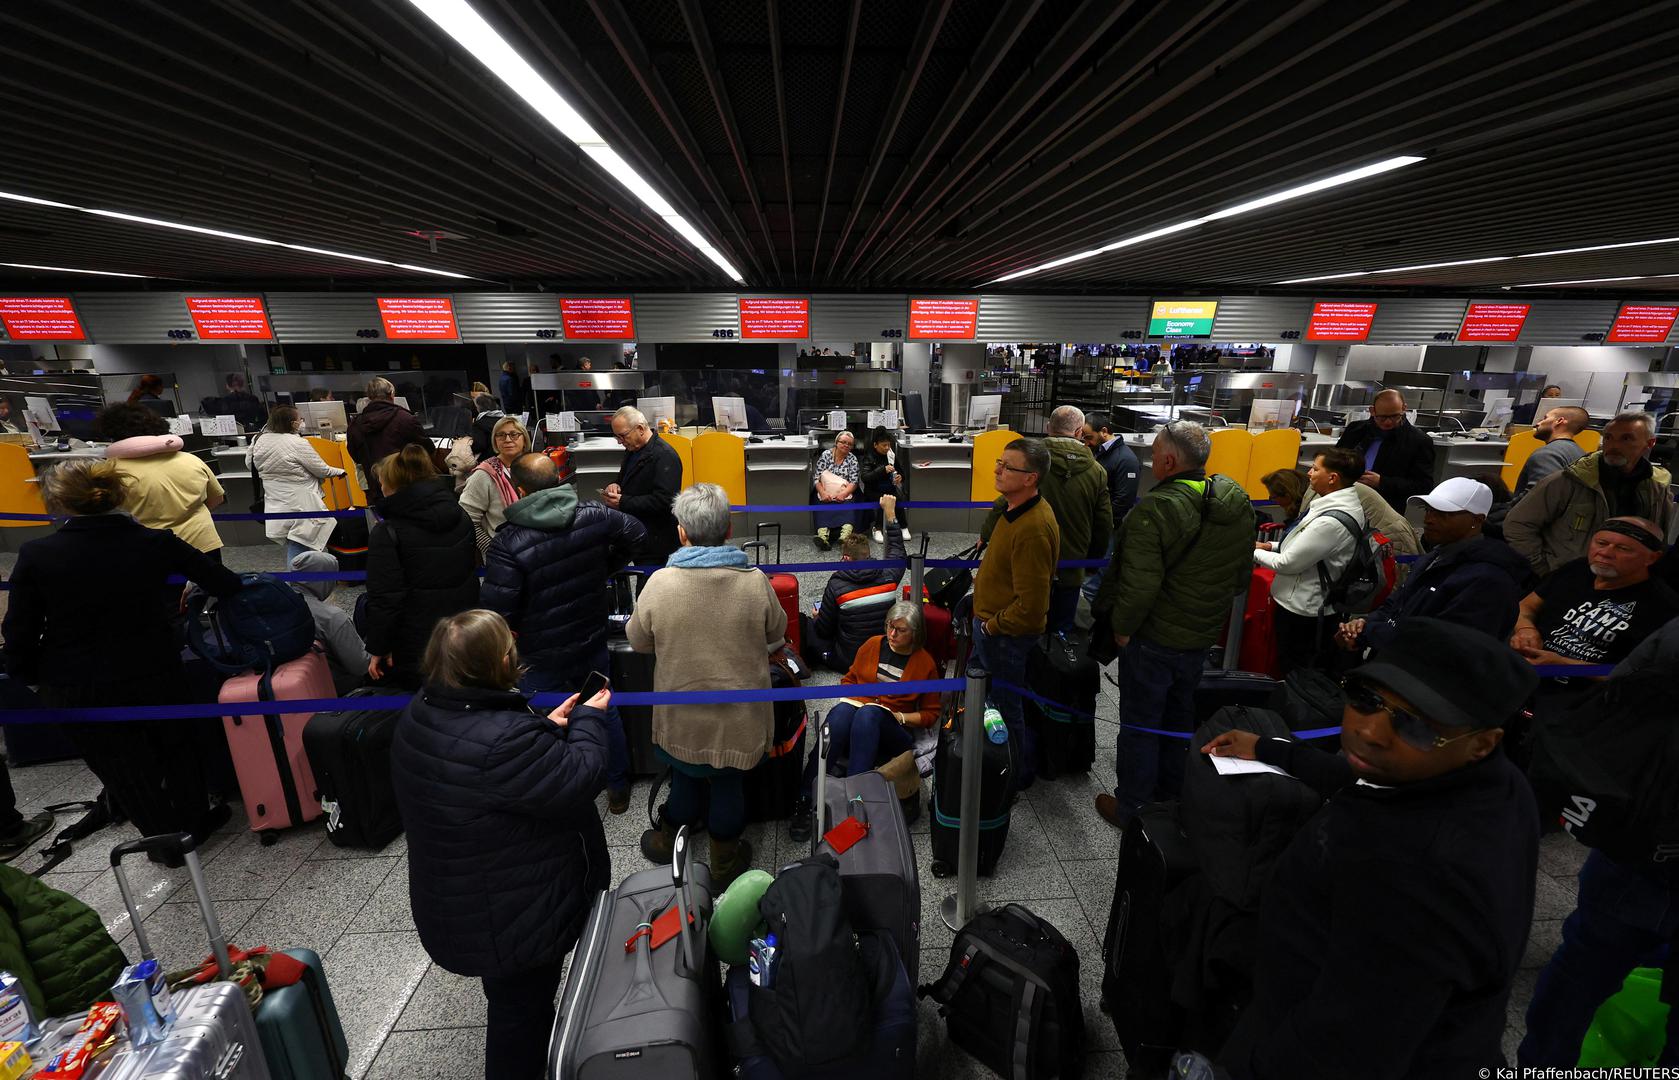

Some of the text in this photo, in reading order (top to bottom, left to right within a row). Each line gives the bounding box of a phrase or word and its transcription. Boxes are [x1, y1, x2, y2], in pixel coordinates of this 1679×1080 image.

[1166, 320, 1195, 328] Economy
[536, 329, 557, 339] 487
[712, 329, 734, 338] 486
[881, 329, 902, 338] 485
[1121, 330, 1142, 339] 483
[1280, 330, 1300, 340] 482
[1578, 601, 1630, 631] CAMP
[1563, 608, 1617, 643] DAVID
